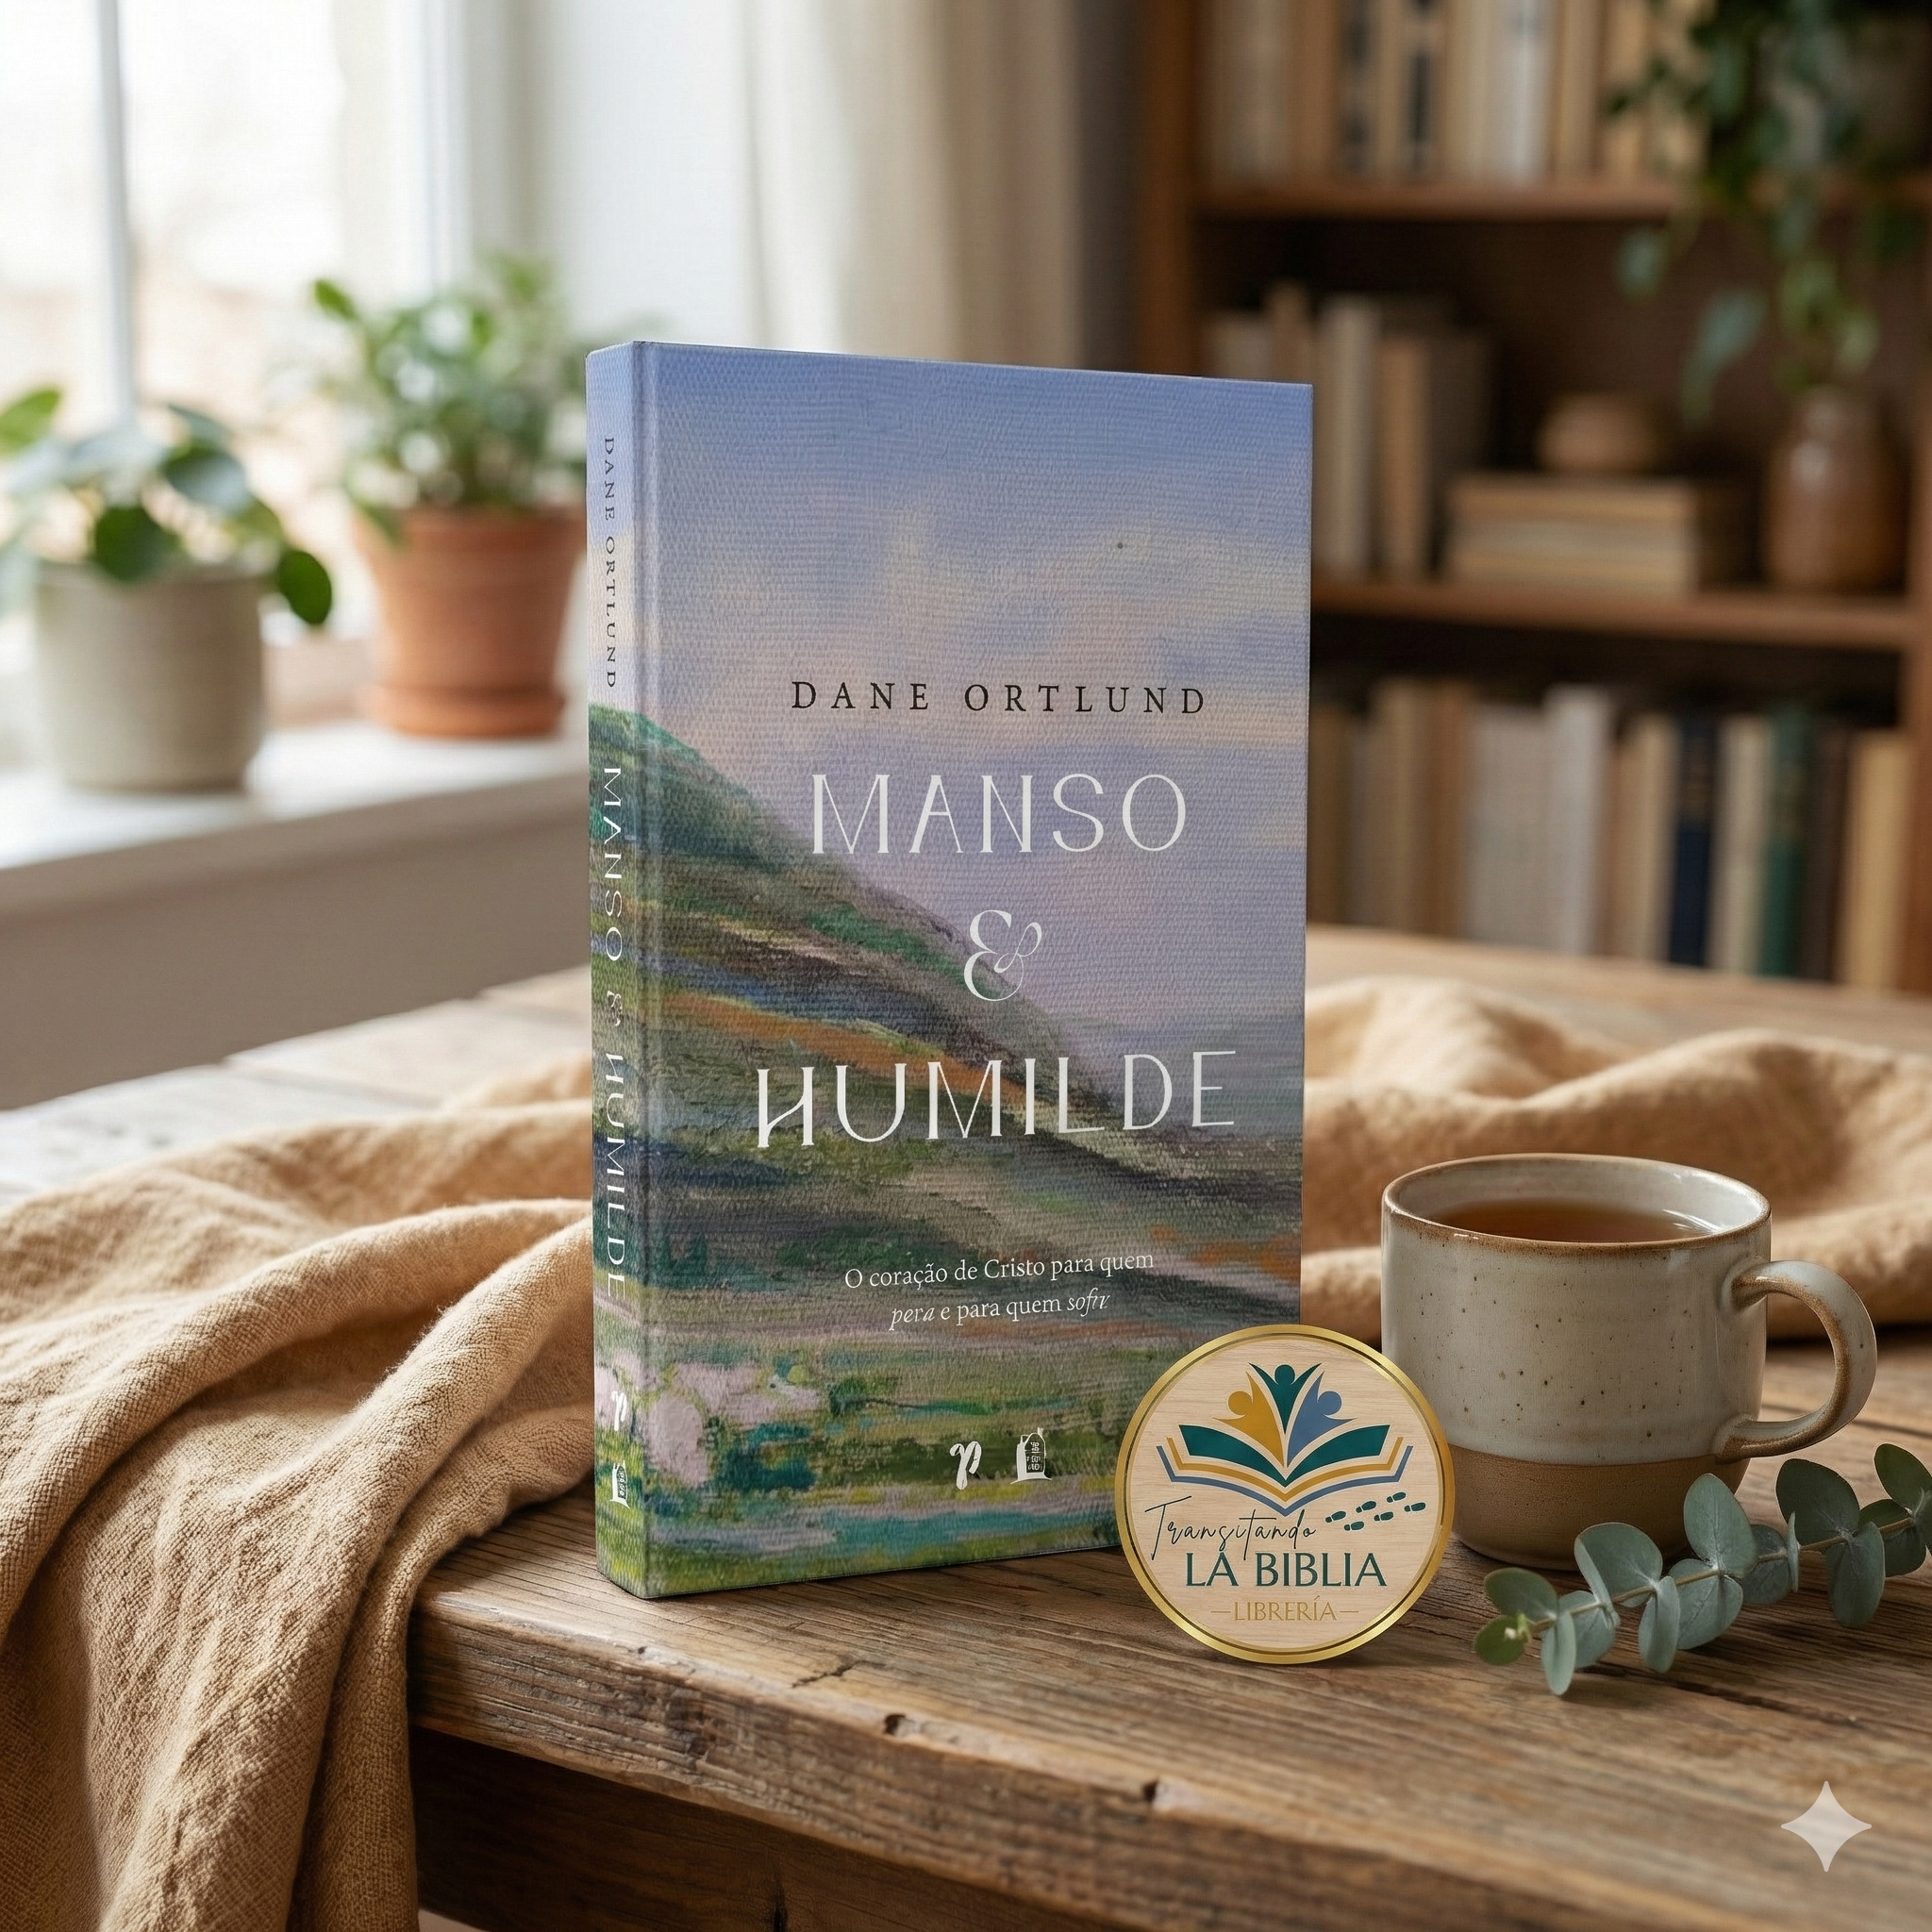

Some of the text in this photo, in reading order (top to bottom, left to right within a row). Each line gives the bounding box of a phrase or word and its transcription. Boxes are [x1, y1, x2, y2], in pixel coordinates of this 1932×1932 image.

[605, 437, 616, 688] DANE ORTLUND
[791, 681, 1205, 714] DANE ORTLUND
[811, 773, 1186, 854] MANSO
[603, 767, 623, 961] MANSO
[963, 909, 1042, 1002] &
[758, 1050, 1236, 1147] HUMILDE
[606, 1053, 625, 1301] HUMILDE
[845, 1255, 1154, 1291] O coração de Cristo para quem
[889, 1307, 935, 1331] pera
[941, 1306, 951, 1321] e
[957, 1302, 1000, 1326] para
[1007, 1298, 1062, 1322] quem
[1144, 1495, 1316, 1561] Transitando
[1186, 1552, 1388, 1588] LA BIBLIA
[1233, 1594, 1338, 1622] LIBRERÍA
